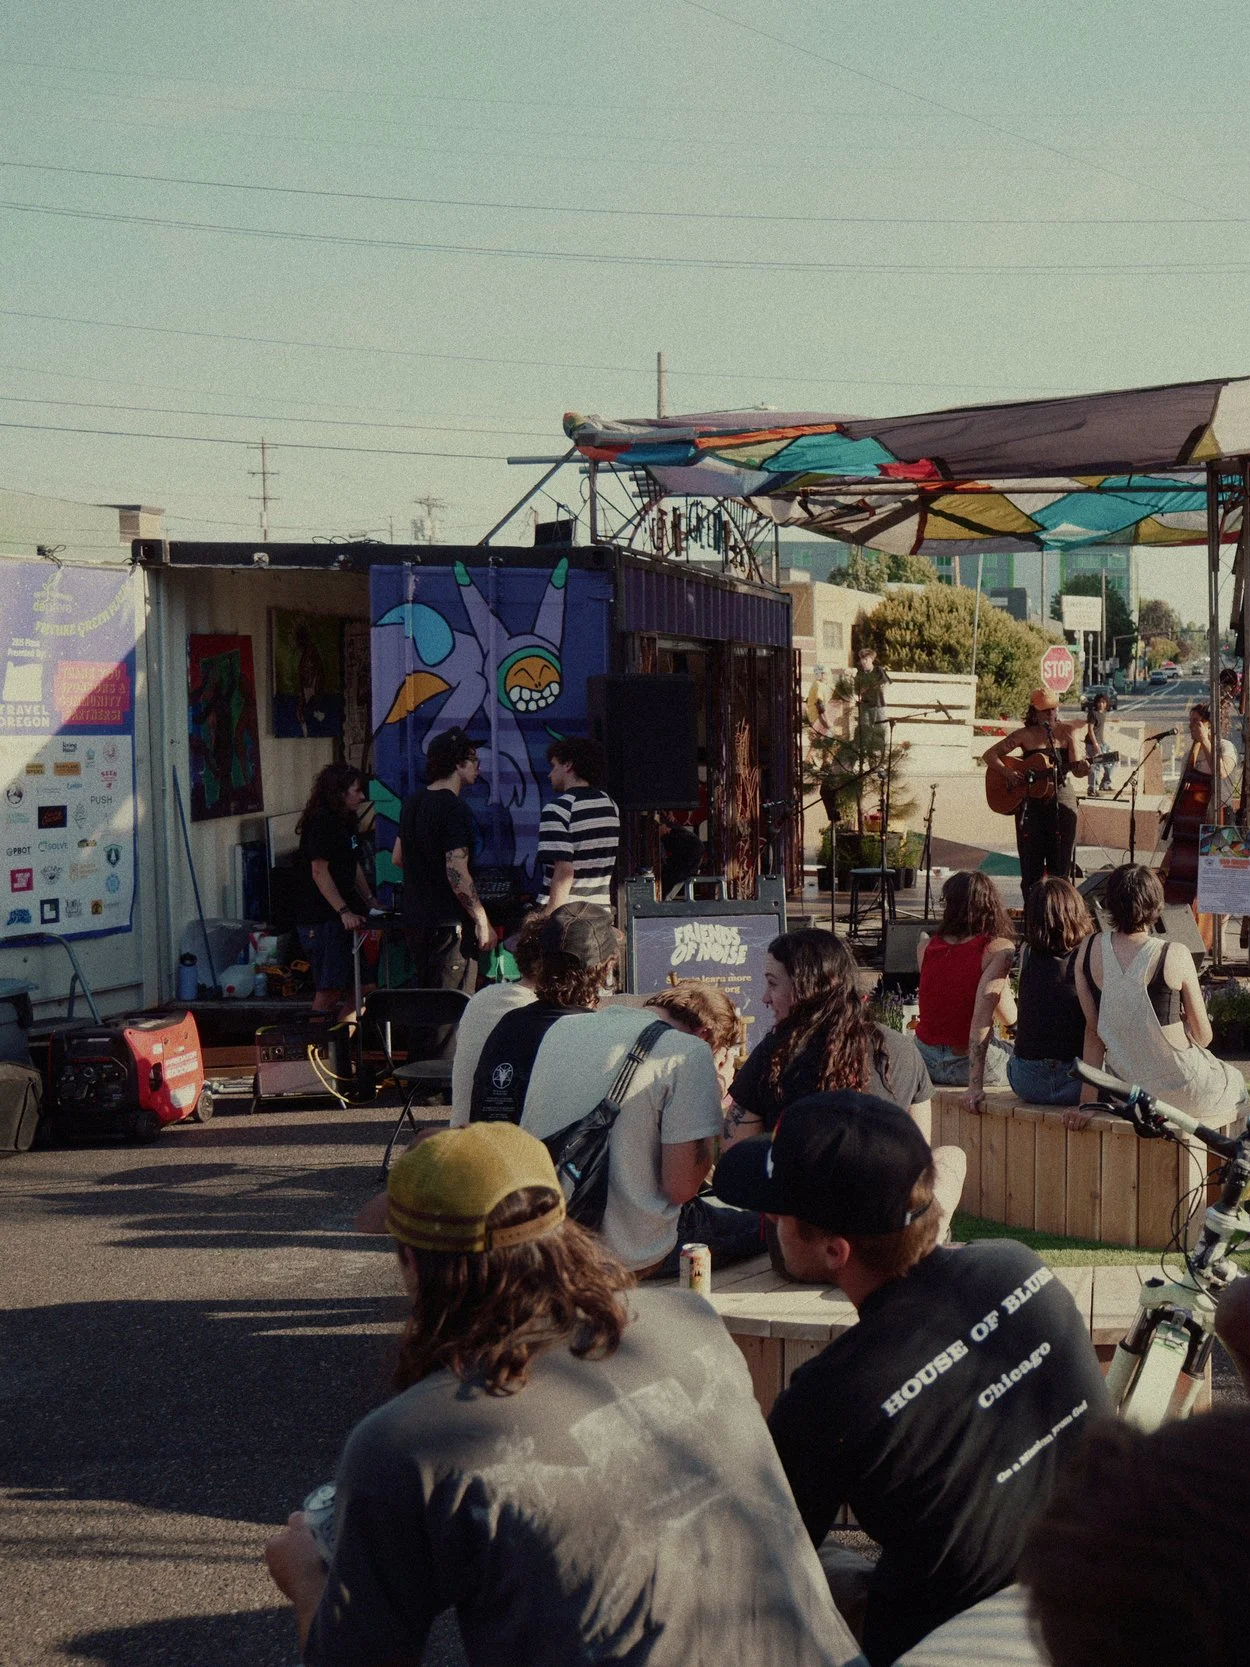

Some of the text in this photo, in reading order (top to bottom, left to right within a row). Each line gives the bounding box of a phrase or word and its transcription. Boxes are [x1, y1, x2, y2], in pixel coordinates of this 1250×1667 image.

[1044, 661, 1072, 679] STOP
[0, 704, 49, 715] TRAVEL
[0, 716, 50, 727] OREGON
[90, 795, 113, 805] PUSH
[674, 922, 741, 946] FRIENDS
[670, 942, 749, 967] OF NOISE
[880, 1339, 970, 1418] HOUSE
[970, 1309, 999, 1342] OF
[978, 1341, 1051, 1409] Chicago
